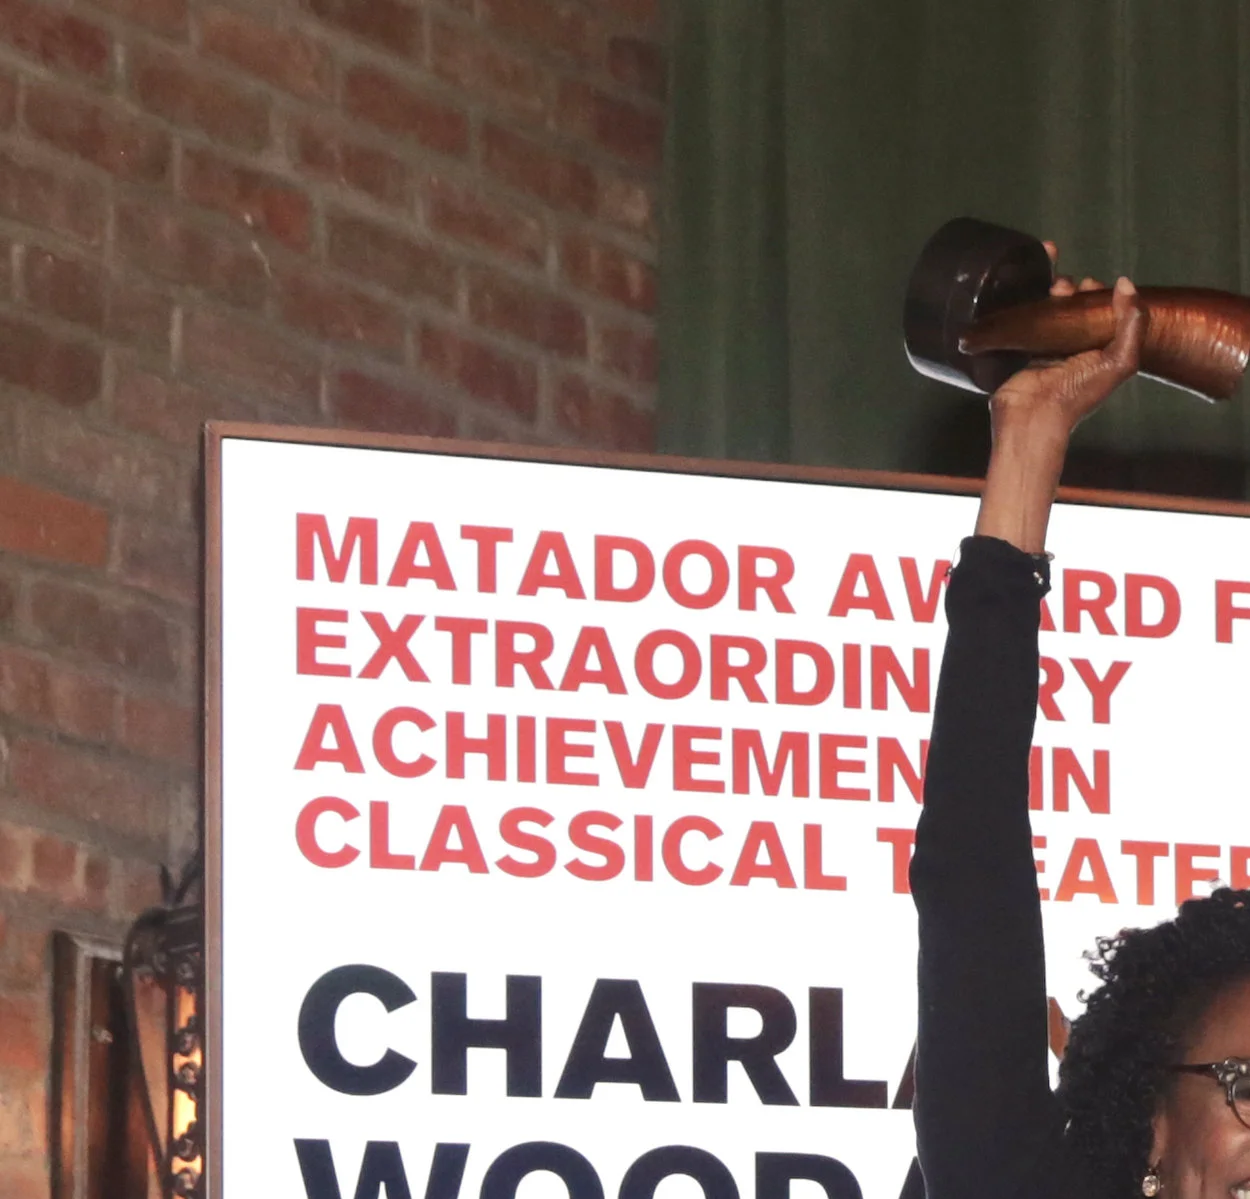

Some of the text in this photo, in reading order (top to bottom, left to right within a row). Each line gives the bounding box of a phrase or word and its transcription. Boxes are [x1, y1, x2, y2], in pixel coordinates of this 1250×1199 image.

[297, 513, 795, 615] MATADOR
[829, 553, 1182, 640] AWRD
[297, 607, 1131, 725] EXTRAORDINY
[296, 704, 1111, 814] ACHIEVEMEN IN
[296, 796, 848, 891] CLASSICAL
